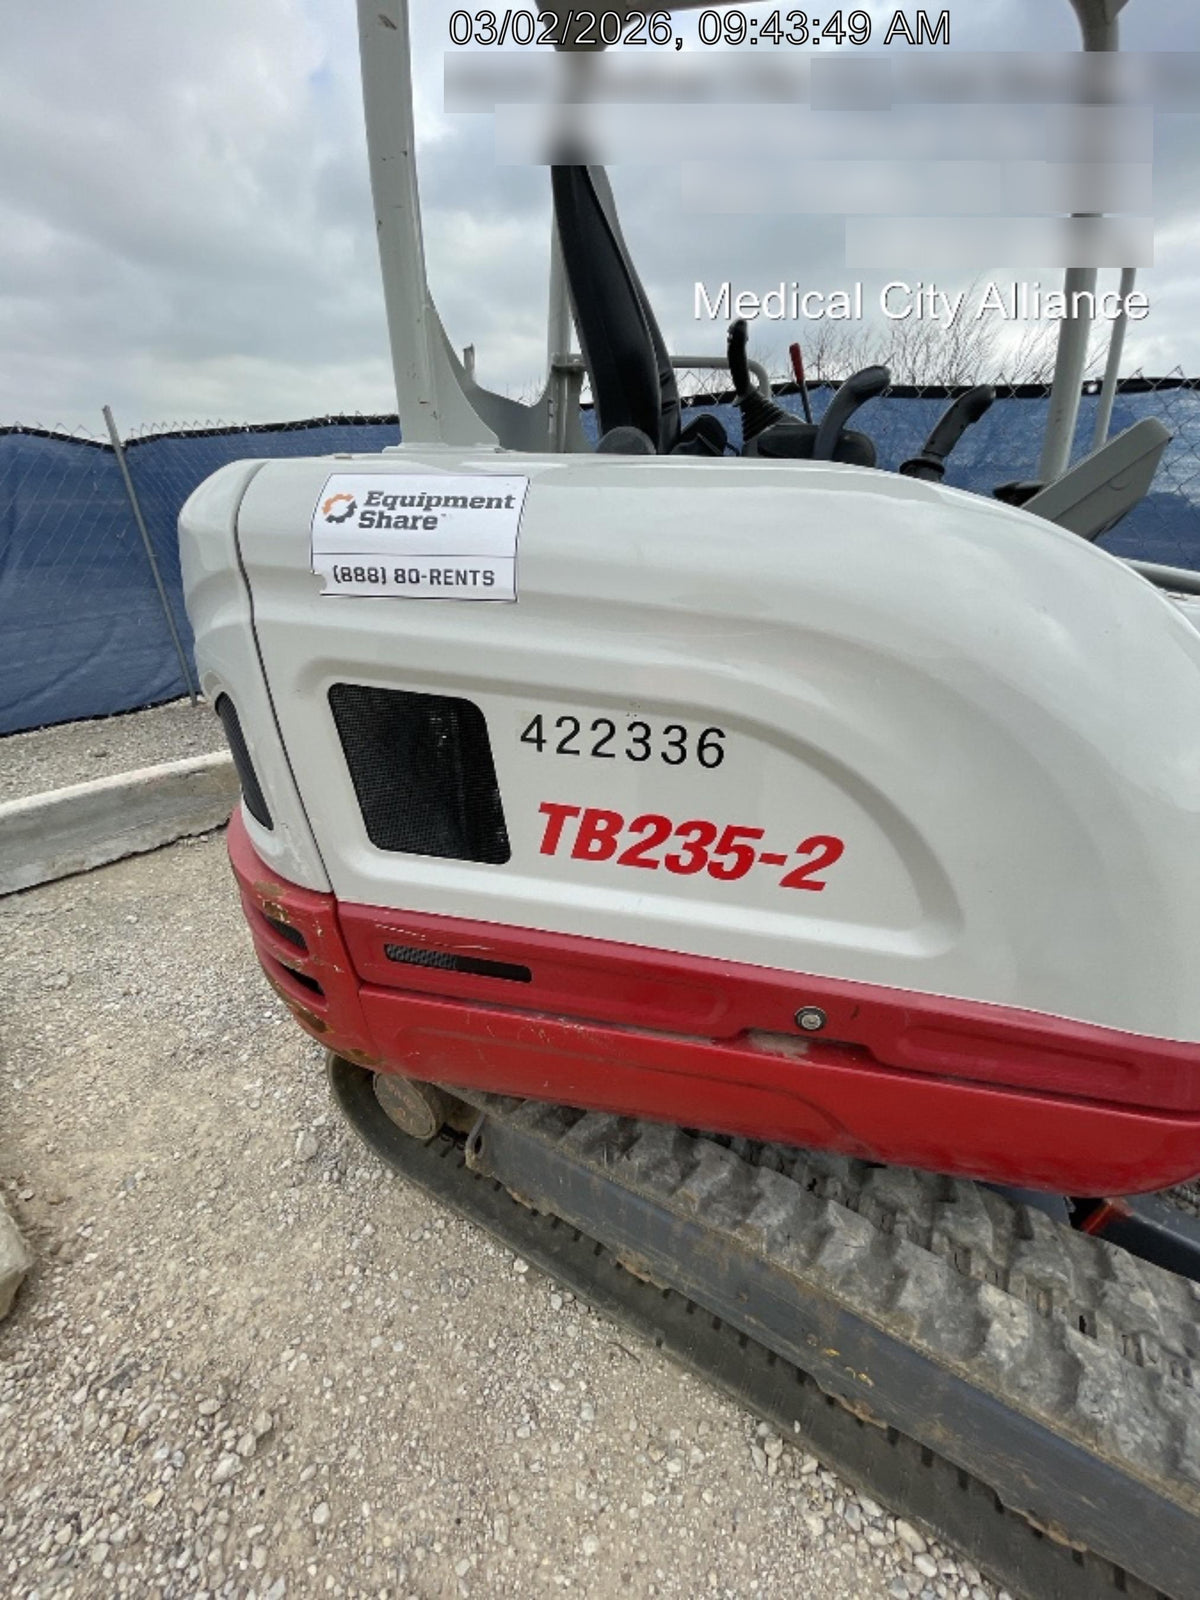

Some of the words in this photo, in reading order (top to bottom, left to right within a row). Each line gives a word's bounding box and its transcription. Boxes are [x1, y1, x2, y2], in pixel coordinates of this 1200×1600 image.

[364, 490, 517, 511] Equipment
[358, 510, 438, 531] Share
[333, 565, 387, 585] (888)
[394, 568, 495, 587] 80-RENTS
[520, 714, 727, 769] 422336
[538, 802, 845, 892] TB235-2
